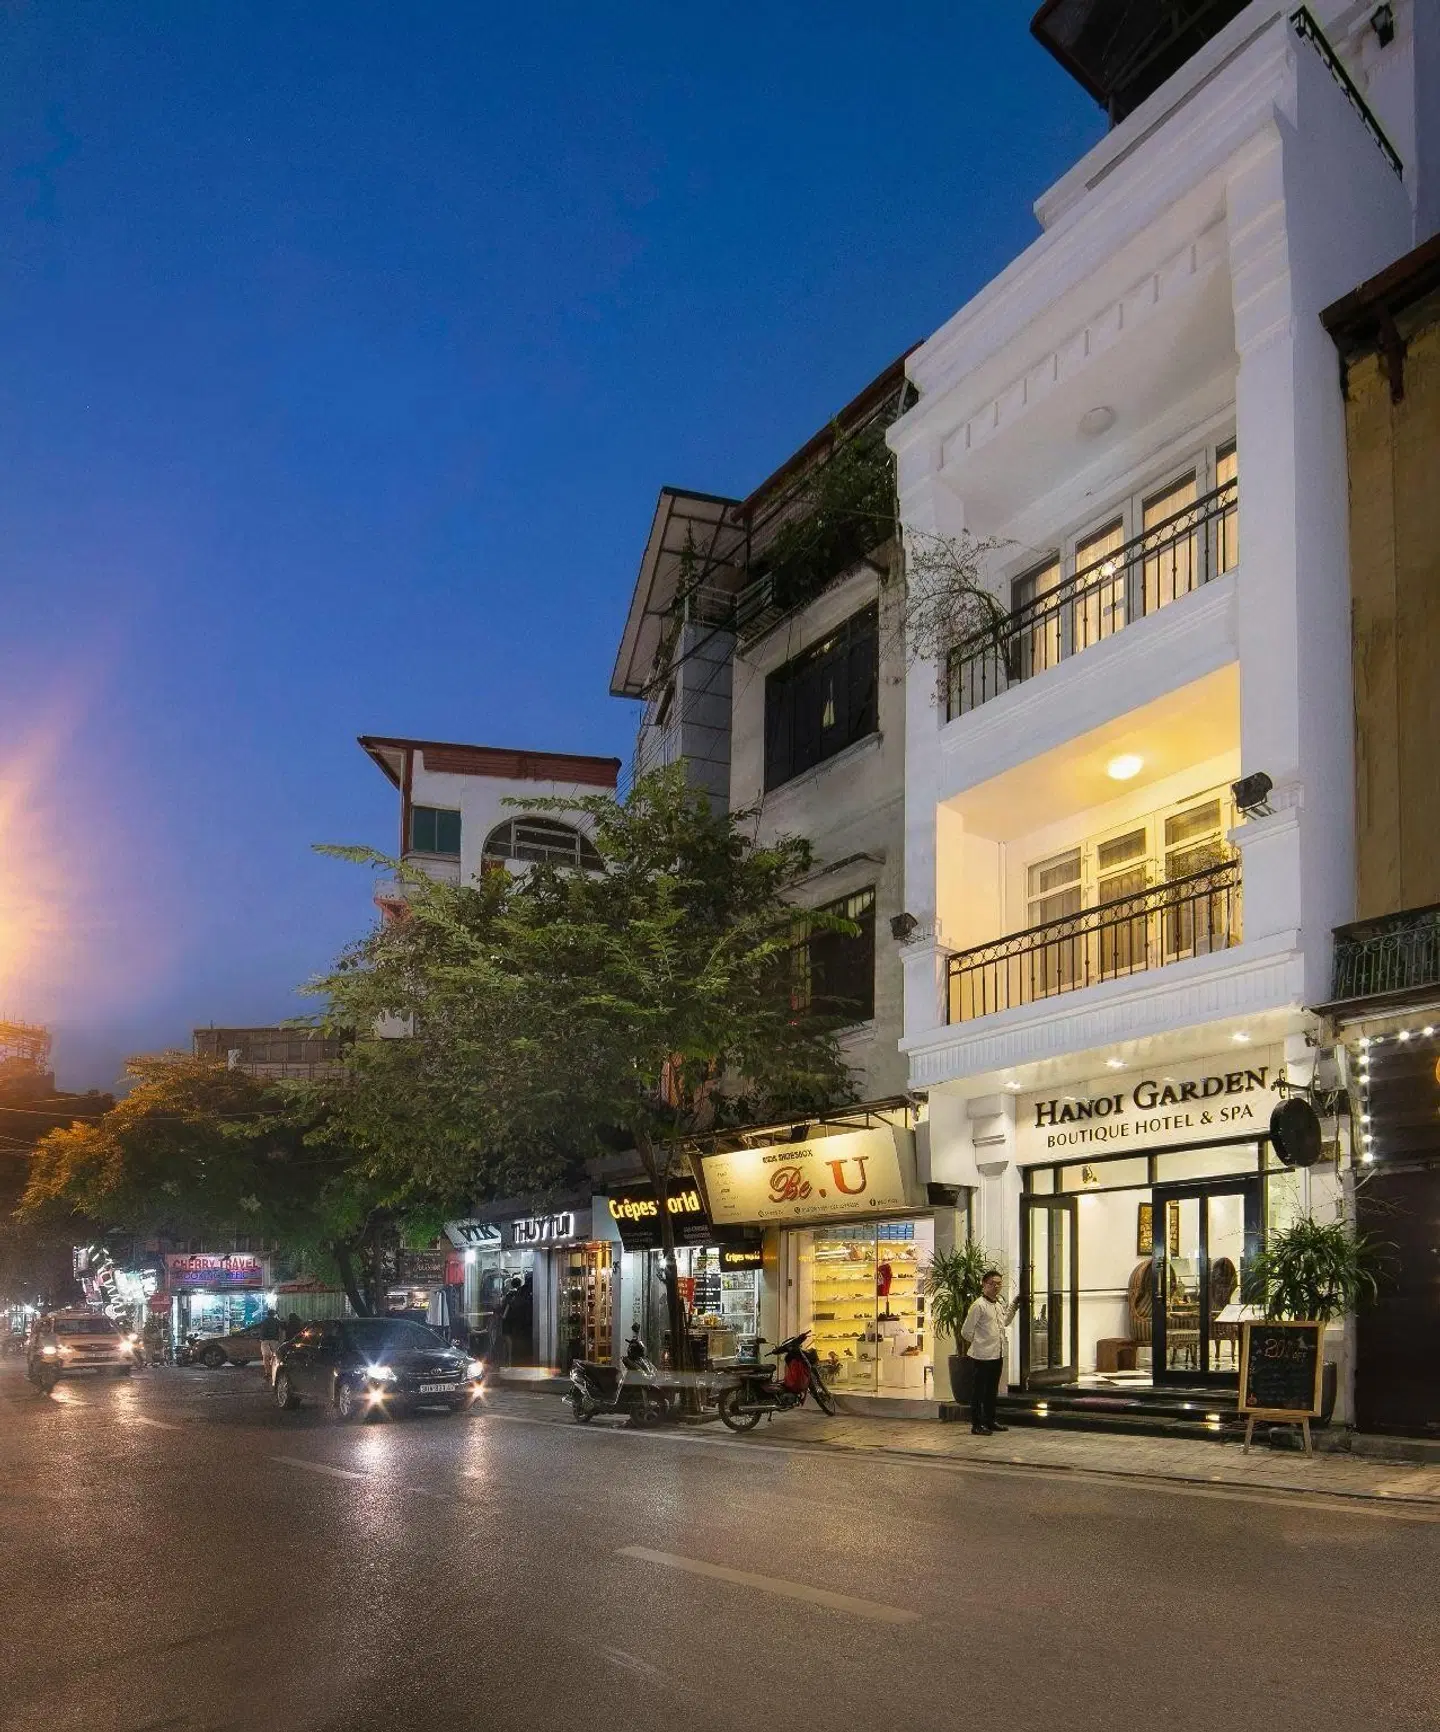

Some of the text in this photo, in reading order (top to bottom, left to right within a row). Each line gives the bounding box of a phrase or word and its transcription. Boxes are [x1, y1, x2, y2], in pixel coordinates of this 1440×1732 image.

[1035, 1066, 1269, 1128] HANOI GARDEN
[1047, 1104, 1254, 1148] BOUTIQUE HOTEL & SPA
[608, 1190, 700, 1222] Crêpes orld
[173, 1257, 259, 1270] CHERRY TRAVEL
